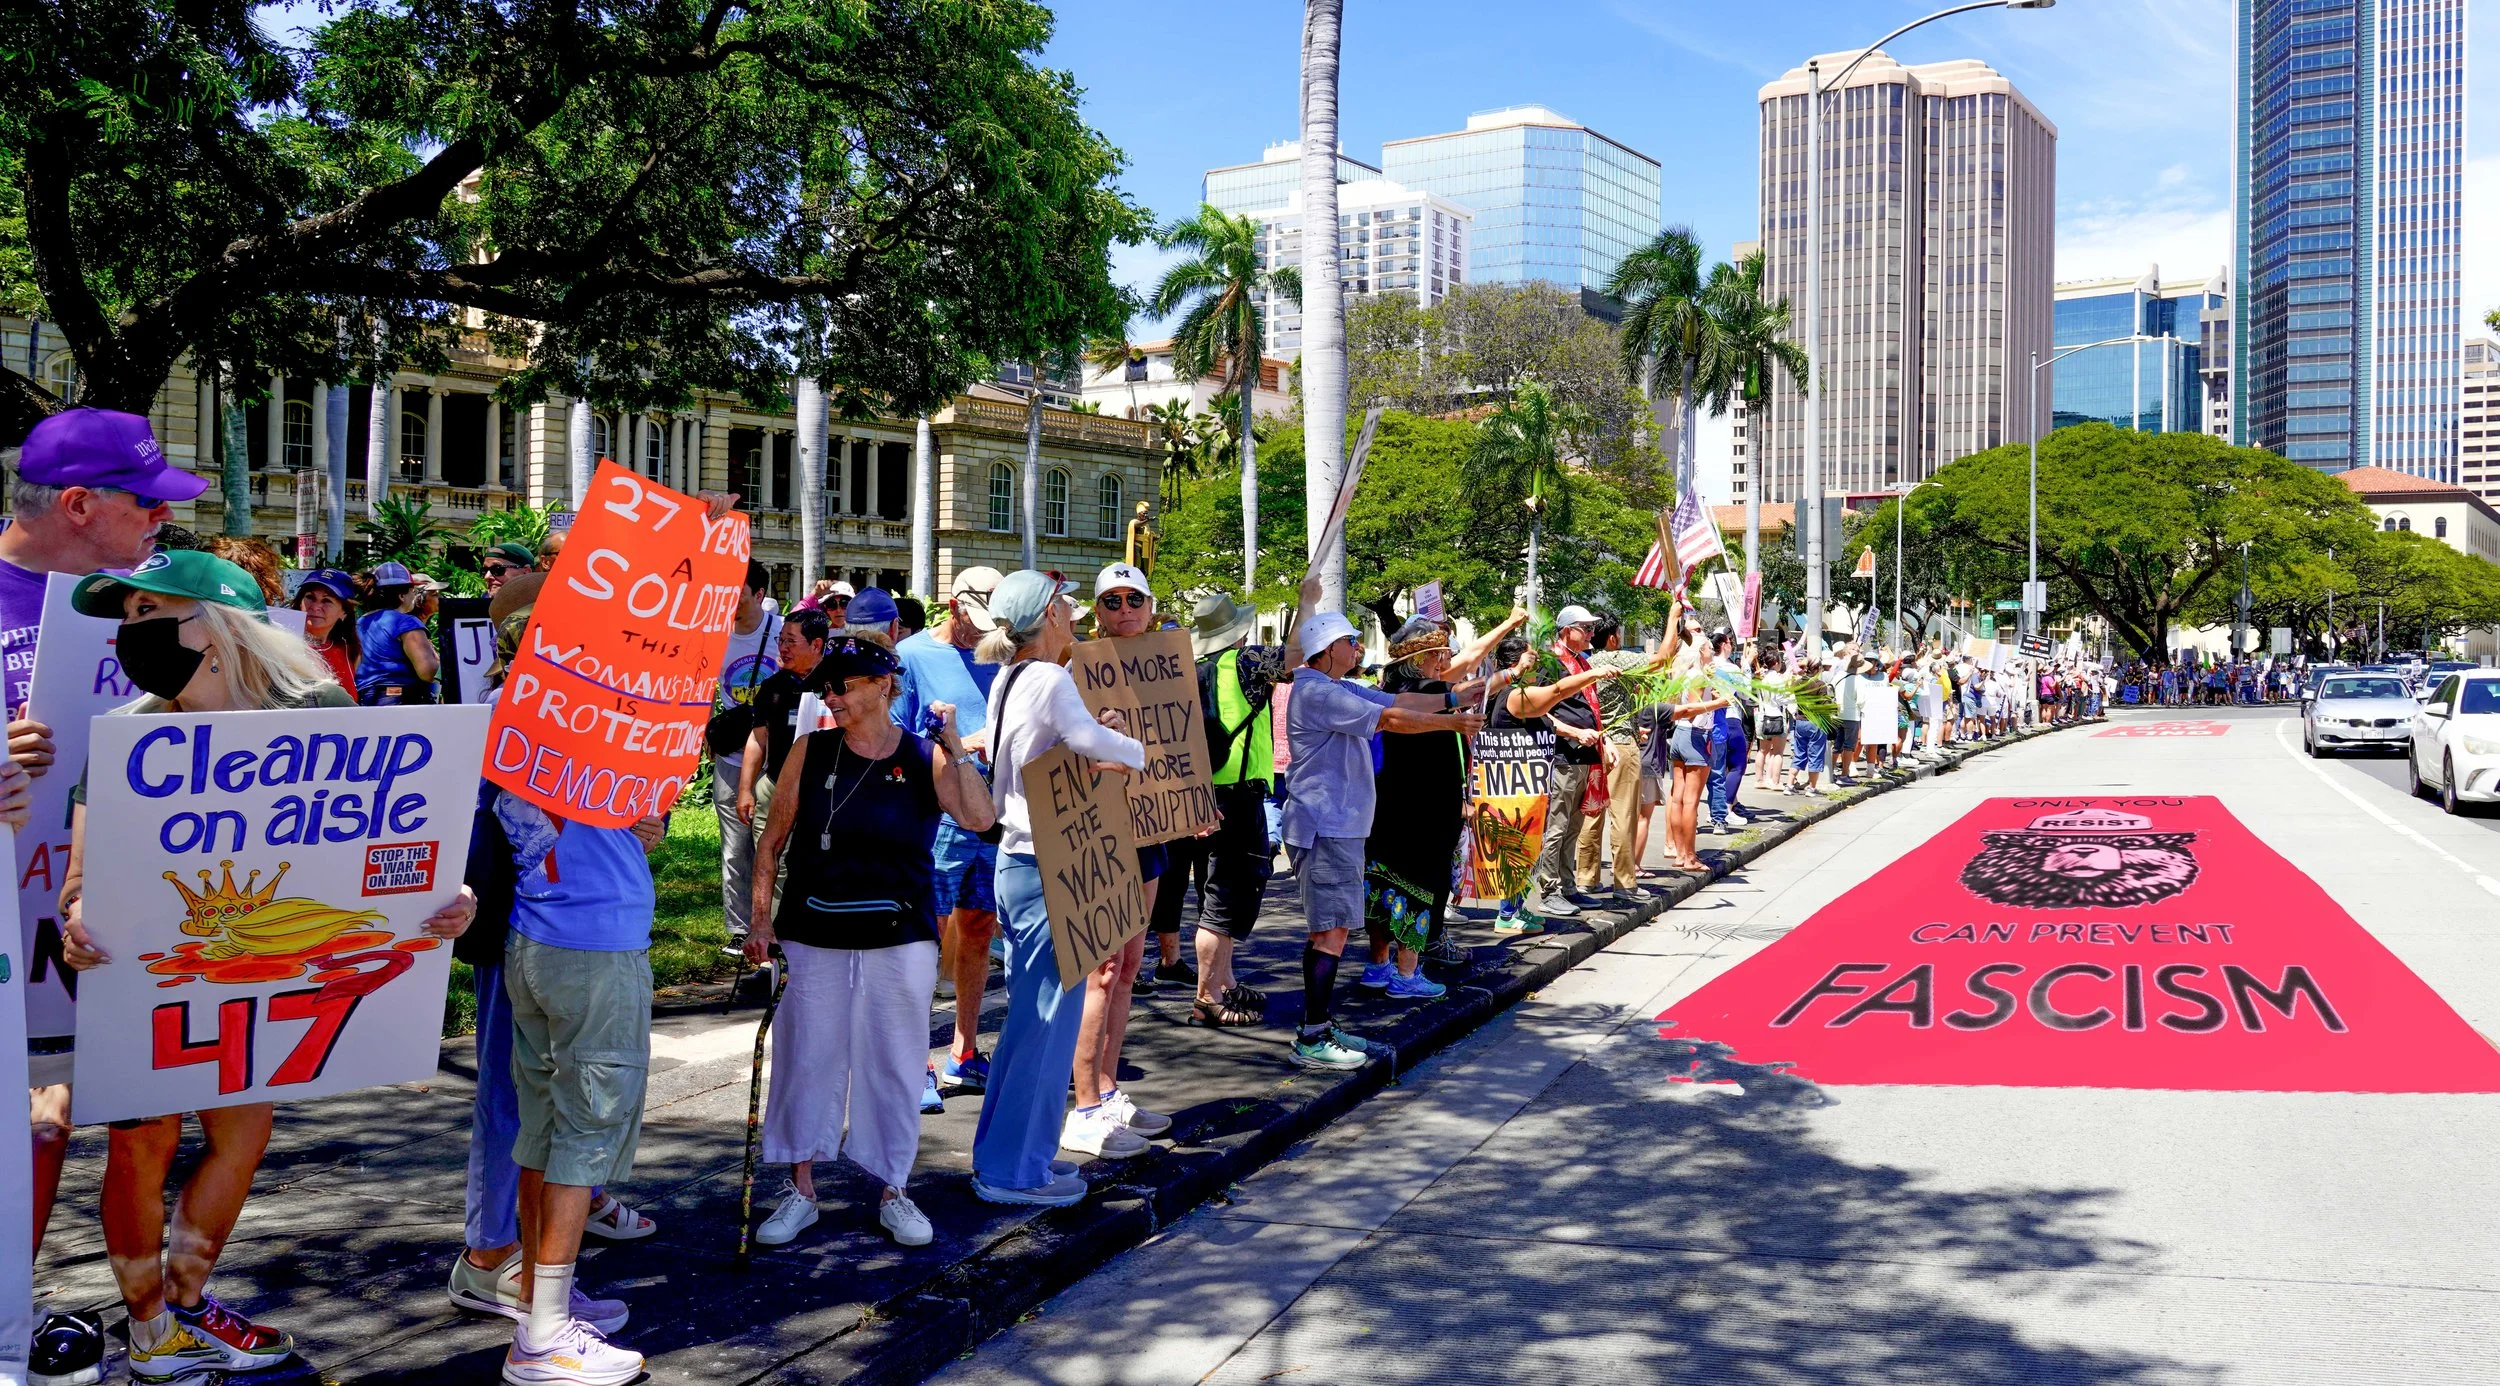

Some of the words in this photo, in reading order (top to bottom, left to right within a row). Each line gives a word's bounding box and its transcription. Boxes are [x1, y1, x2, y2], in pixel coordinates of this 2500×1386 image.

[604, 475, 682, 533] 27
[671, 557, 693, 582] A
[1113, 569, 1131, 579] M
[621, 629, 681, 658] THIS
[533, 623, 683, 702] WOMAN'S
[681, 674, 719, 704] PLACE
[732, 656, 768, 670] OPERATN
[1083, 661, 1116, 691] NO
[1119, 653, 1184, 687] MORE
[511, 672, 706, 758] PROTECTING
[614, 696, 638, 716] IS
[1479, 731, 1499, 747] This
[1500, 732, 1511, 747] is
[1511, 732, 1534, 747] the
[1499, 749, 1513, 758] and
[1514, 748, 1524, 758] all
[126, 724, 433, 798] Cleanup
[1139, 752, 1196, 786] MORE
[1484, 759, 1556, 798] MAR
[2013, 799, 2097, 808] ONLY
[2113, 799, 2184, 808] YOU
[160, 810, 248, 854] on
[264, 789, 428, 845] aisle
[1060, 803, 1102, 853] THE
[2041, 818, 2141, 828] RESIST
[371, 849, 405, 864] STOP
[406, 847, 429, 861] THE
[383, 860, 415, 875] WAR
[368, 874, 388, 888] ON
[389, 872, 425, 887] IRAN!
[1057, 834, 1126, 912] WAR
[1065, 874, 1146, 975] NOW!
[1909, 921, 2018, 944] CAN
[2028, 922, 2235, 946] PREVENT
[1767, 962, 2349, 1034] FASCISM
[150, 985, 372, 1095] 47
